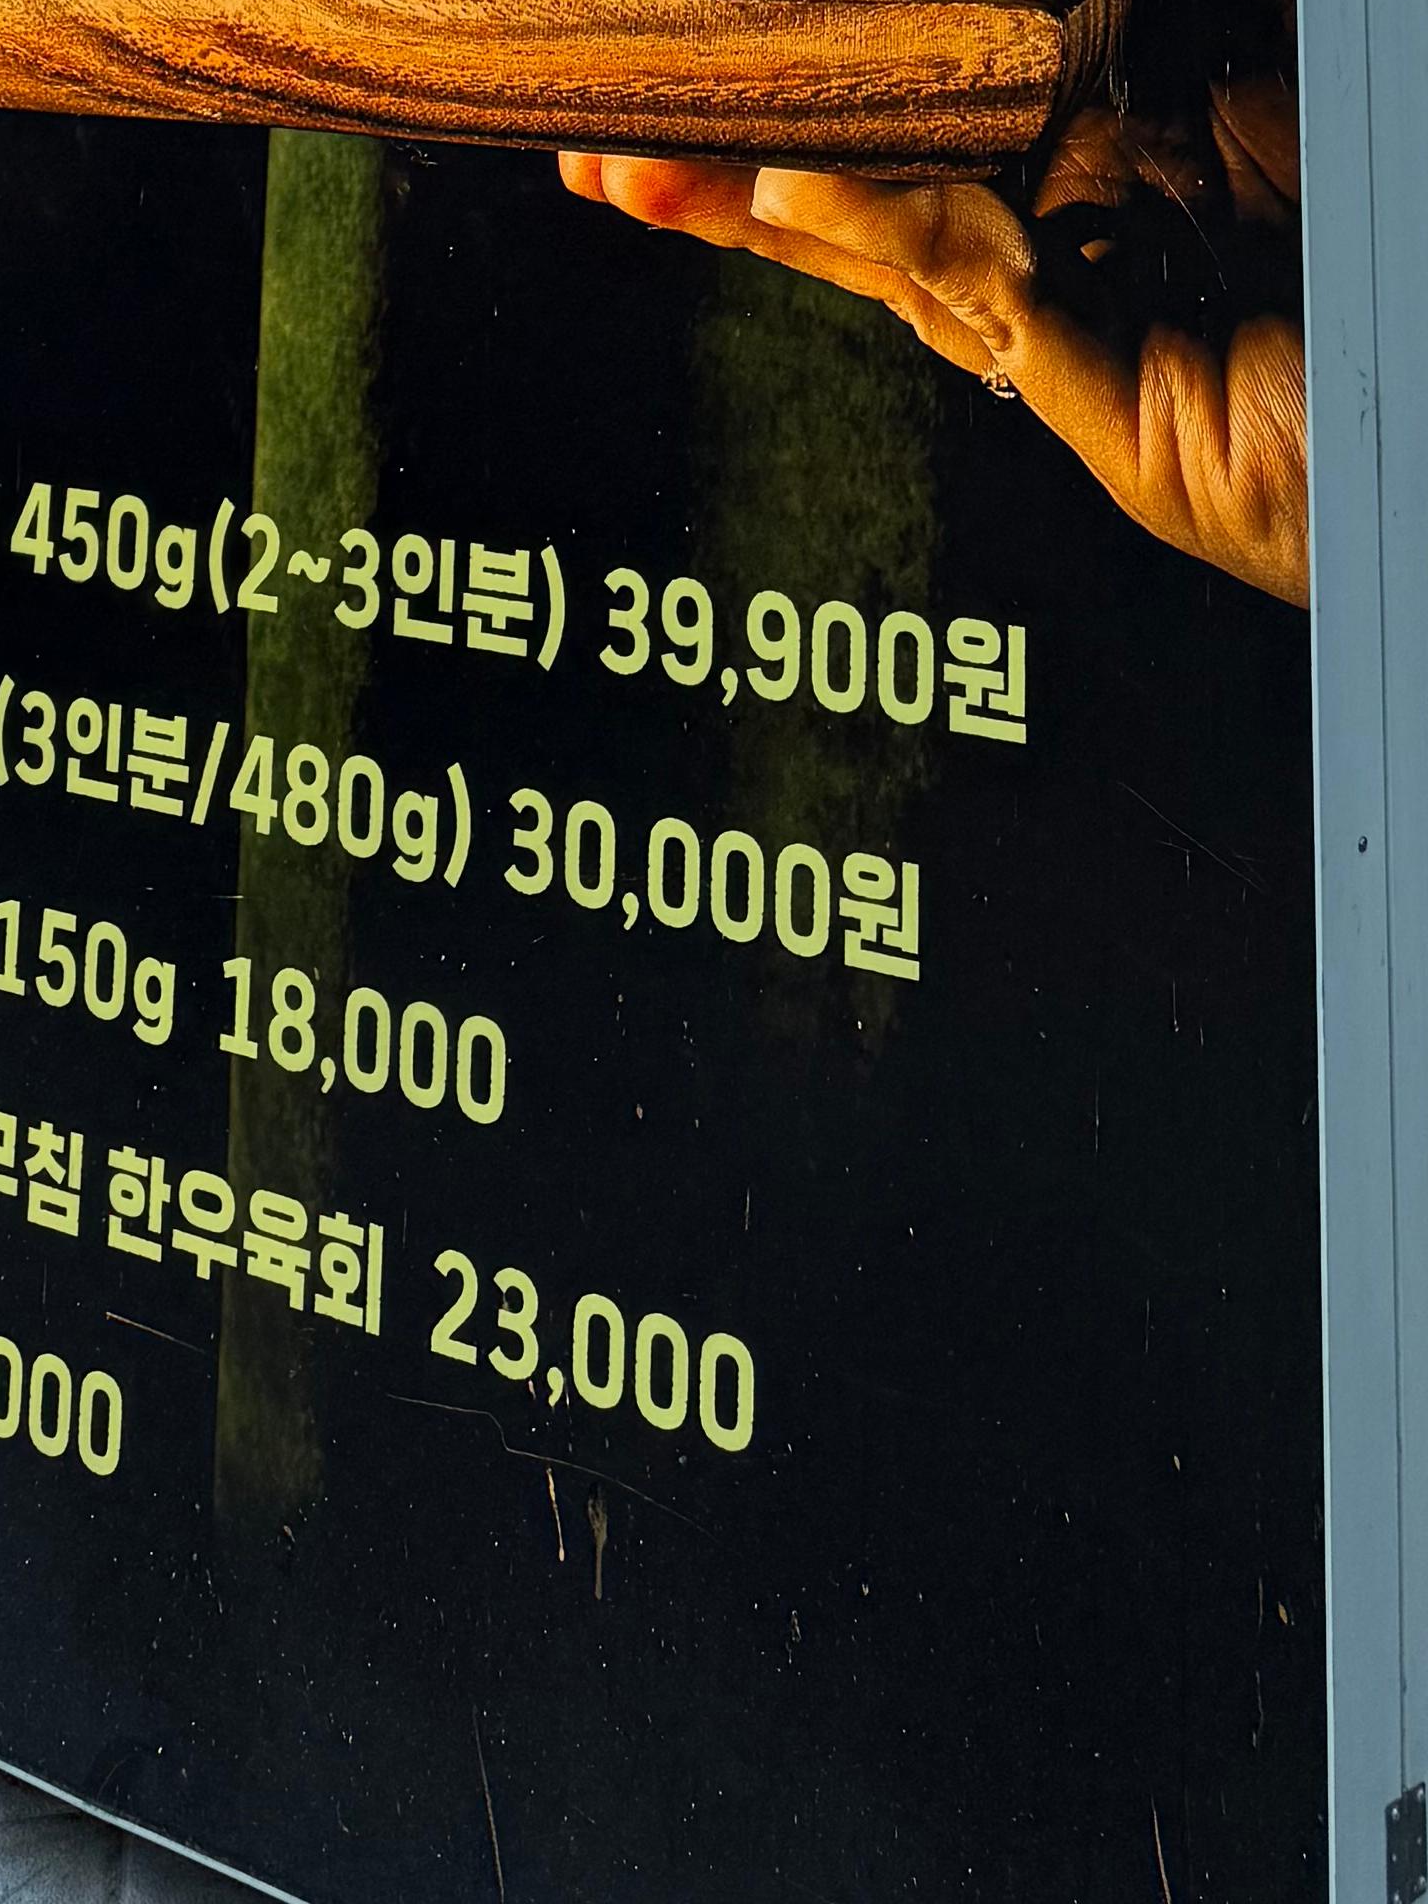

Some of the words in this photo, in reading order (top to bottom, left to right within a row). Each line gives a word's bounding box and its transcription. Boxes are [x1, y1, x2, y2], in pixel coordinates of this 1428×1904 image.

[9, 480, 567, 671] 450g(2~3인분)
[598, 565, 1028, 745] 39,900원
[506, 784, 920, 981] 30,000원
[218, 956, 507, 1126] 18,000
[106, 1142, 385, 1335] 한우육회
[431, 1249, 755, 1452] 23,000
